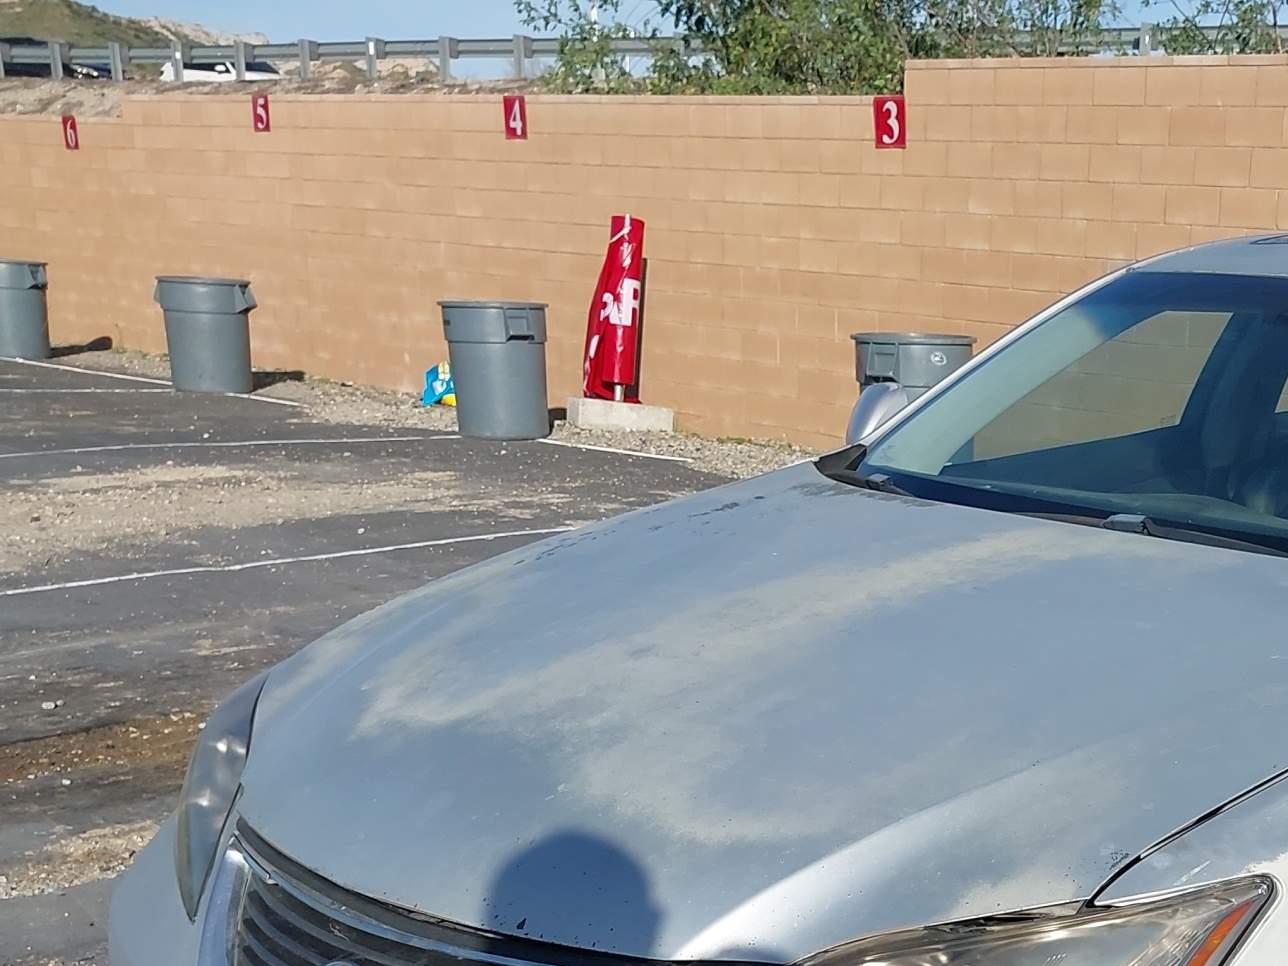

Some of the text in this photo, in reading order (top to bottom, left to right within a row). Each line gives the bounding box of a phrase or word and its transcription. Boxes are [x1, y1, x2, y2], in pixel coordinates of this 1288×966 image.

[256, 97, 267, 129] 5
[509, 99, 523, 136] 4
[881, 100, 900, 145] 3
[66, 119, 76, 148] 6
